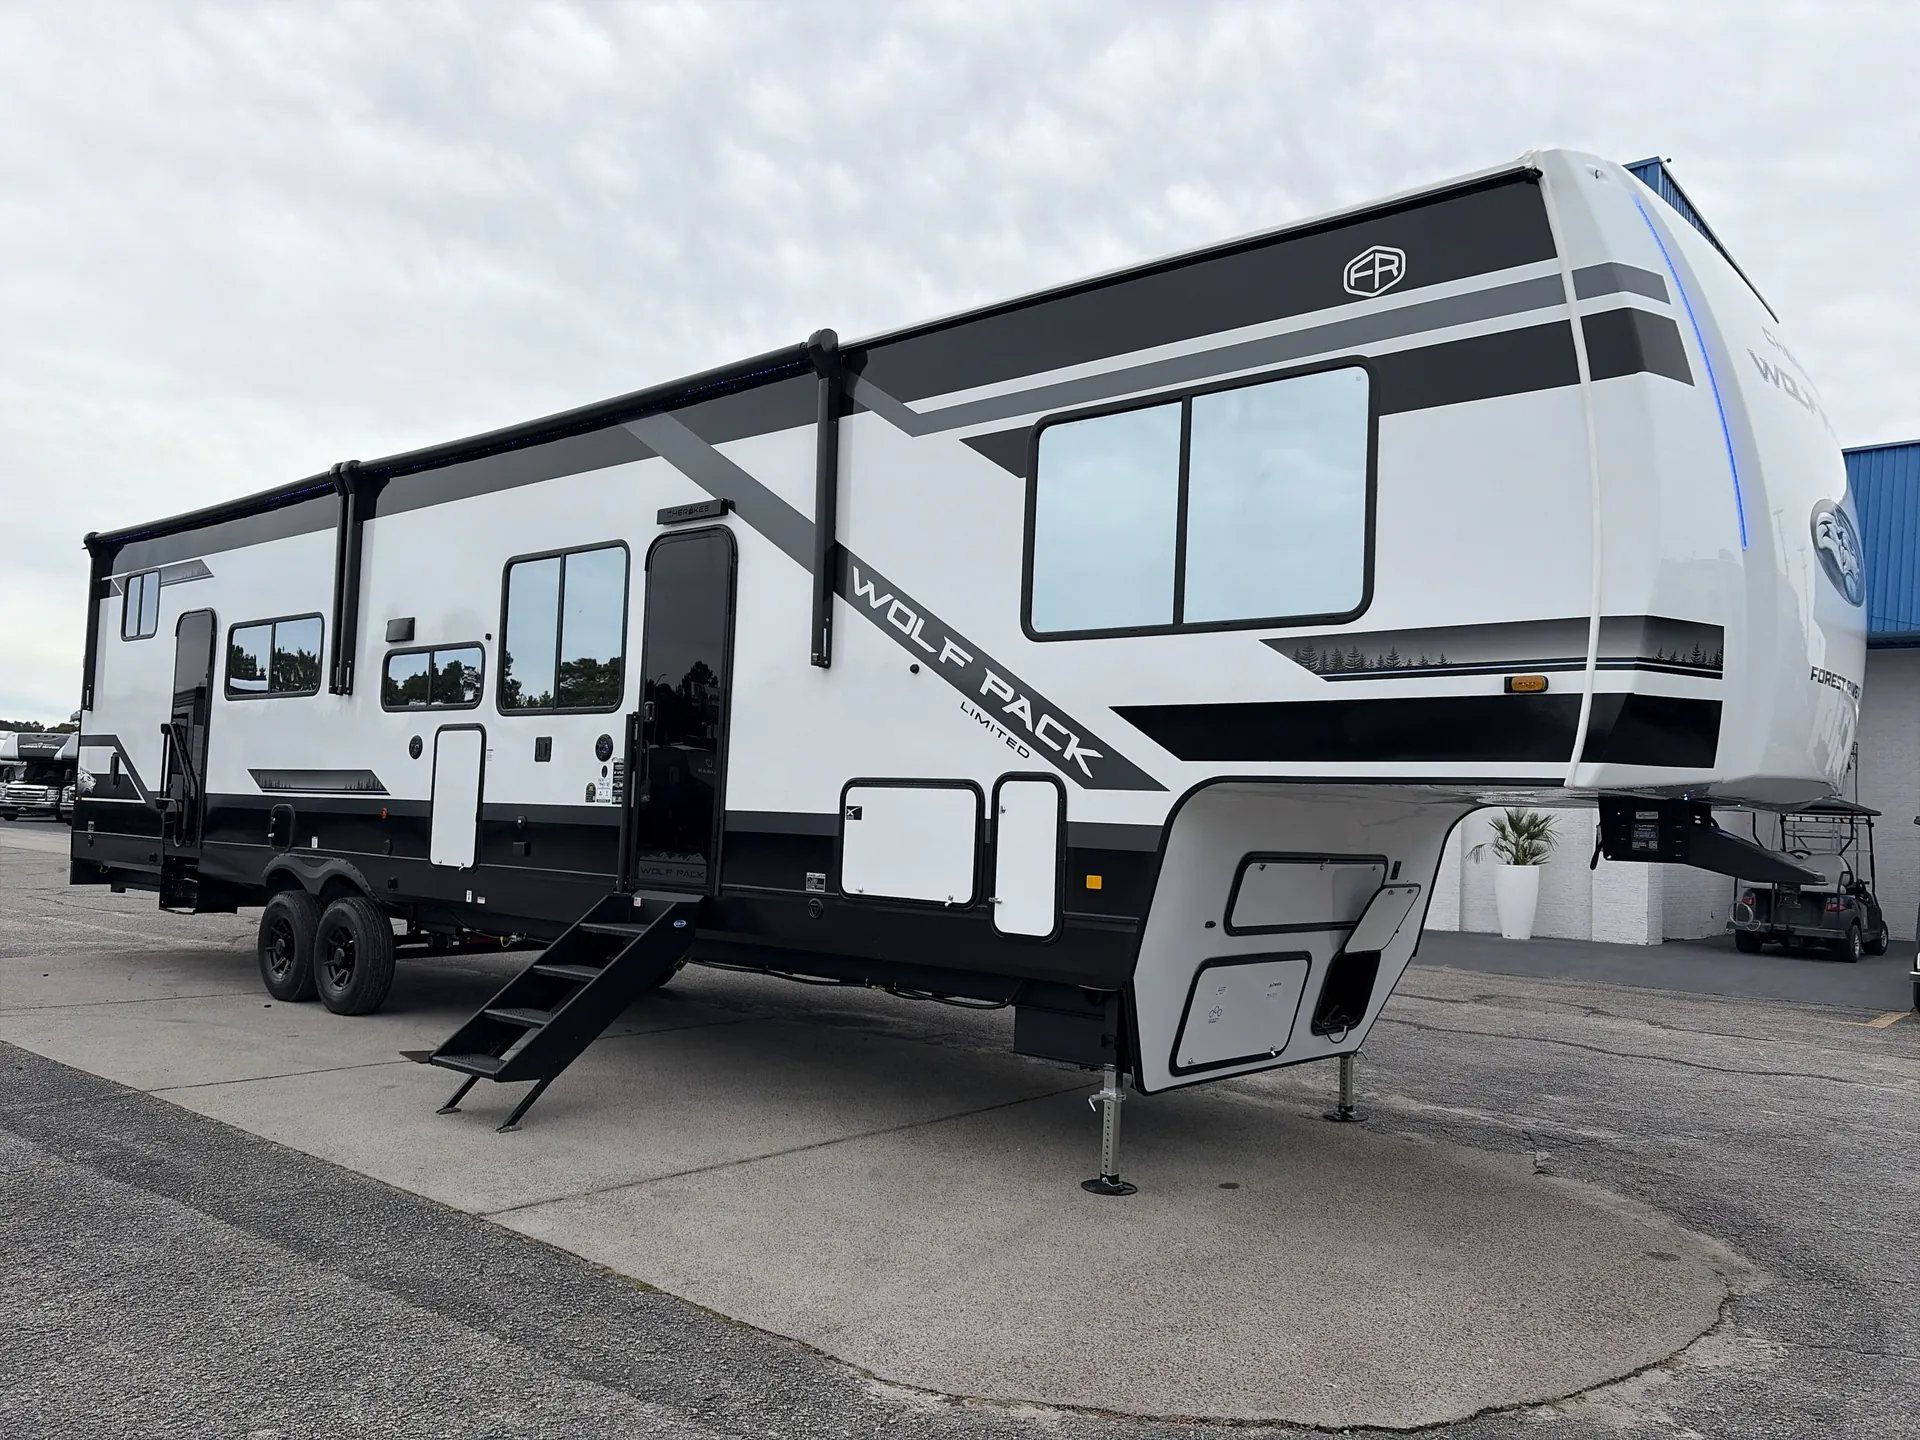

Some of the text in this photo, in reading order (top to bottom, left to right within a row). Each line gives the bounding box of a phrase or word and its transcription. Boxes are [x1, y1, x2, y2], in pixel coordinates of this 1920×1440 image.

[666, 504, 711, 518] CHEROKEE
[852, 565, 1104, 779] WOLF PACK
[1810, 665, 1847, 692] FOREST
[959, 701, 1031, 760] LIMITED
[640, 867, 705, 879] WOLF PACK
